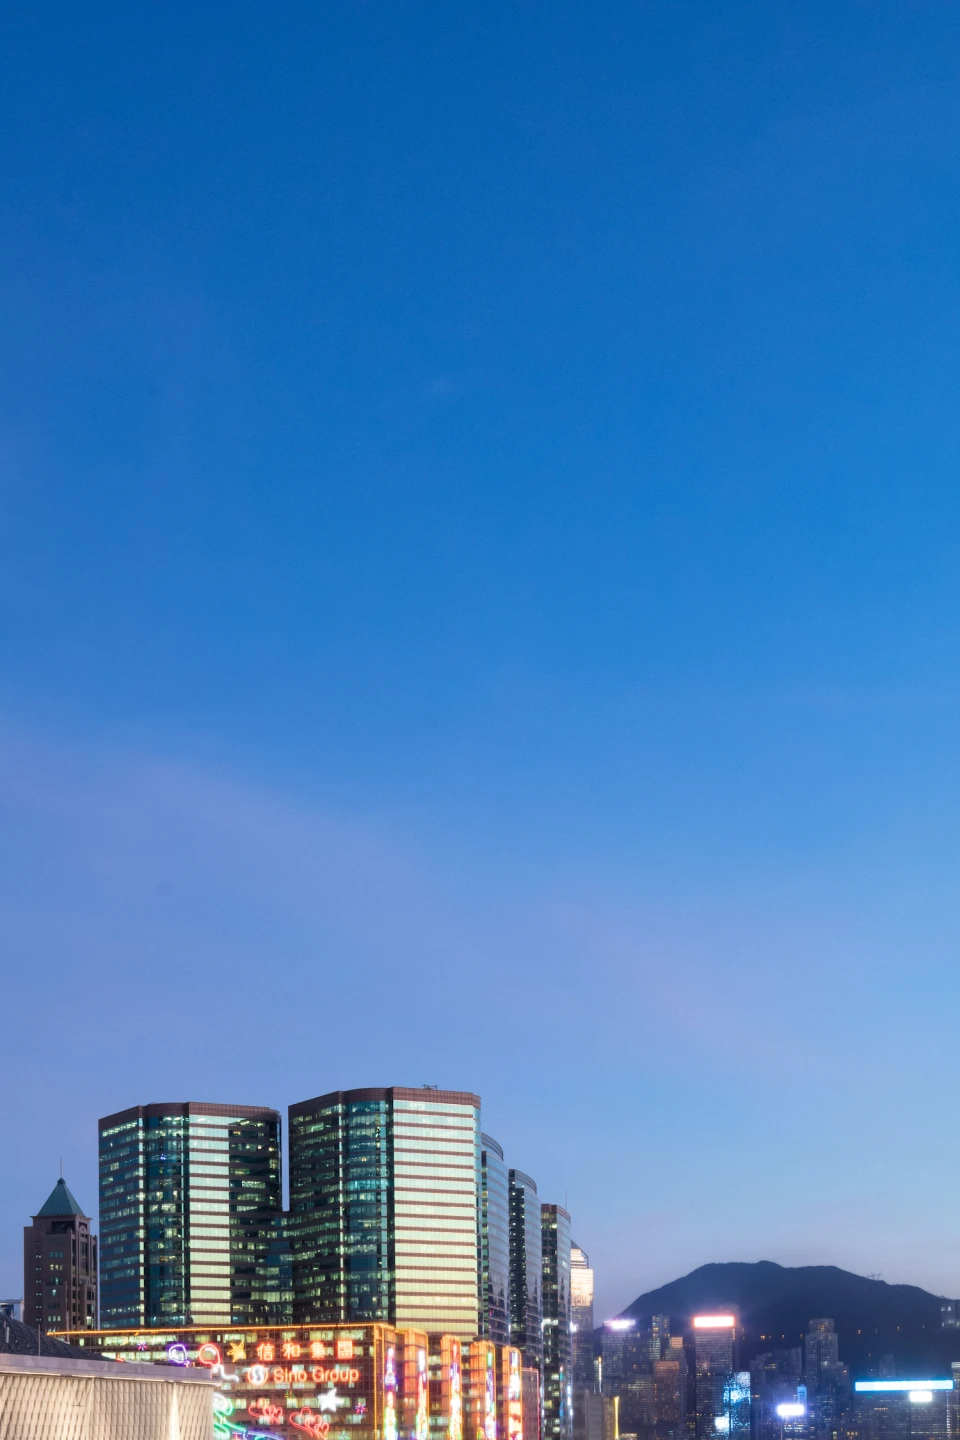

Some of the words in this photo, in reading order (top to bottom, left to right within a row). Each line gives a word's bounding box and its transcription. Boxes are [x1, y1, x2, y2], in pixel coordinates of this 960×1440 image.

[256, 1339, 353, 1361] 信和集團
[273, 1366, 307, 1383] Sino
[312, 1365, 360, 1382] Group
